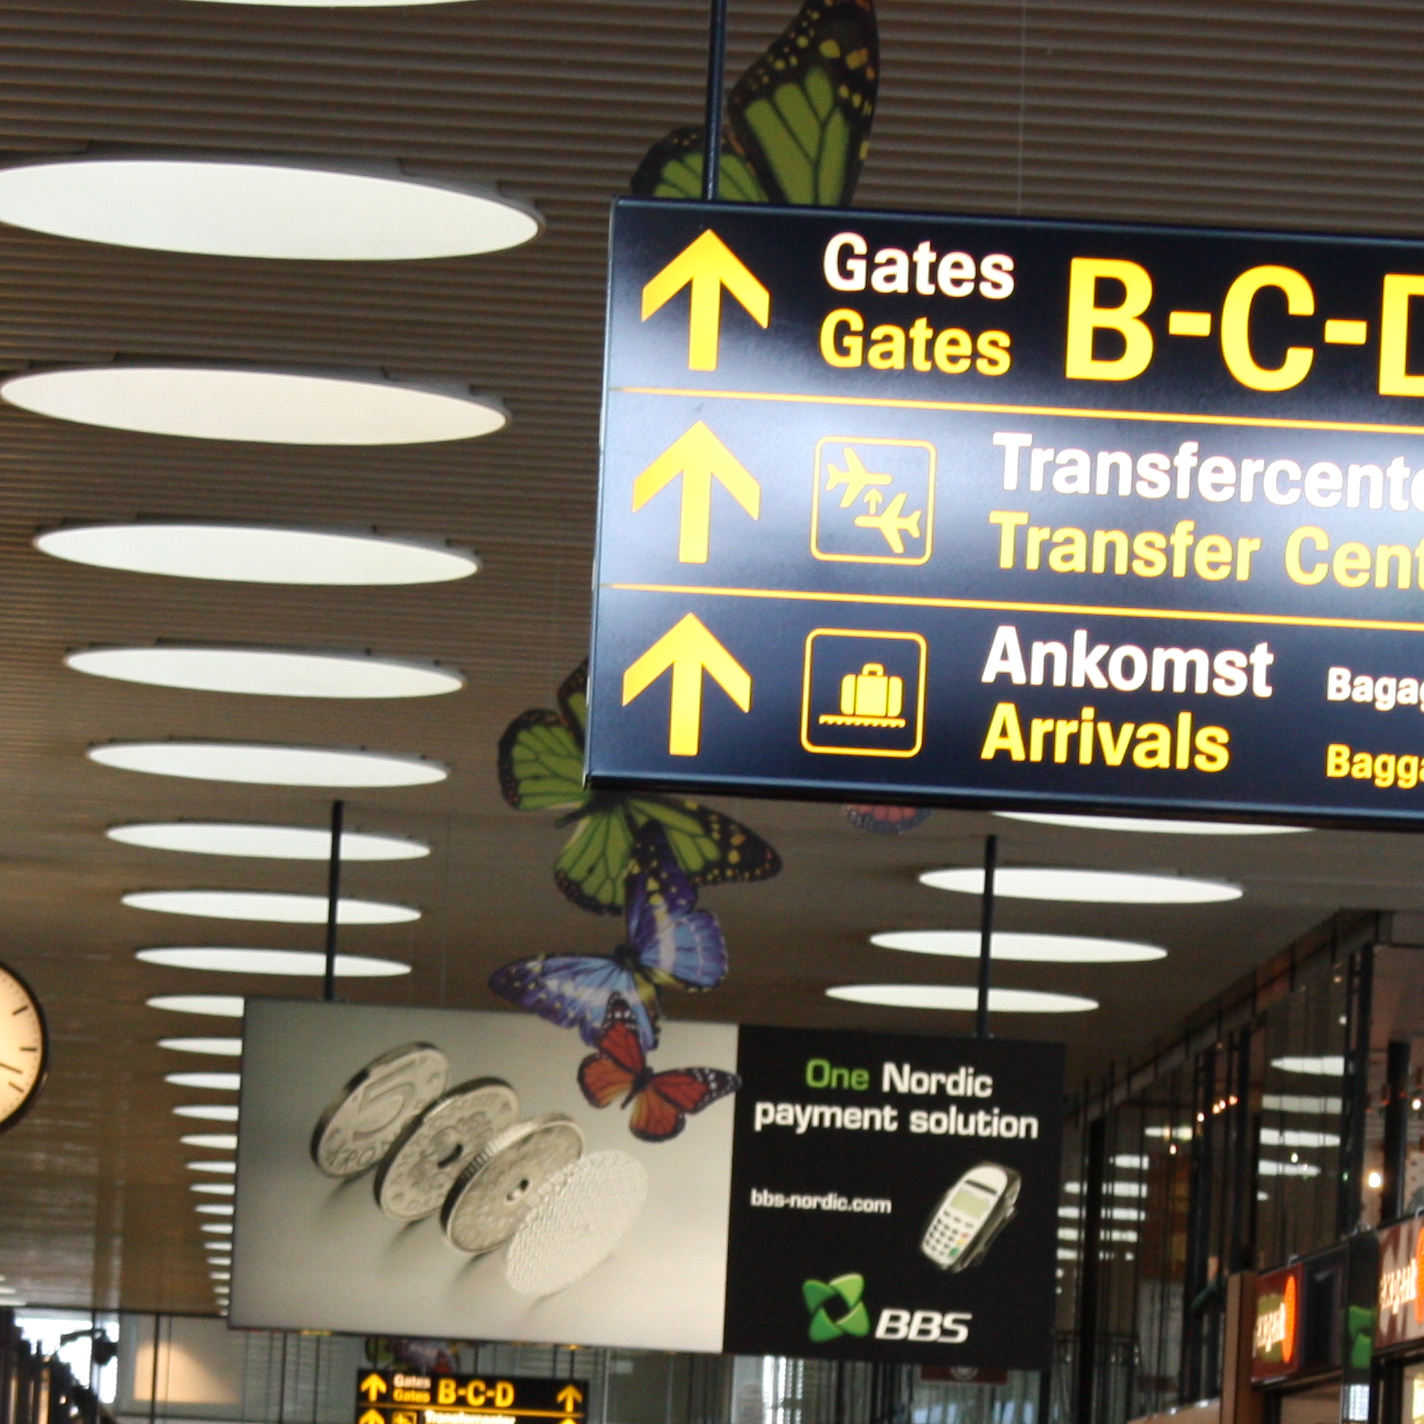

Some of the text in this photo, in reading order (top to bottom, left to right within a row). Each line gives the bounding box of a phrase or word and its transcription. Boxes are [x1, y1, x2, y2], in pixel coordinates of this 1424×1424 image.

[821, 231, 1016, 299] Gates
[817, 310, 1013, 377] Gates
[987, 509, 1262, 584] Transfer
[980, 625, 1275, 699] Ankomst
[979, 702, 1232, 774] Arrivals
[805, 1057, 994, 1098] One Nordic
[754, 1101, 1039, 1139] payment solution
[750, 1187, 893, 1214] bbs-nordic.com
[875, 1307, 973, 1344] BBS
[437, 1378, 515, 1407] B-C-D
